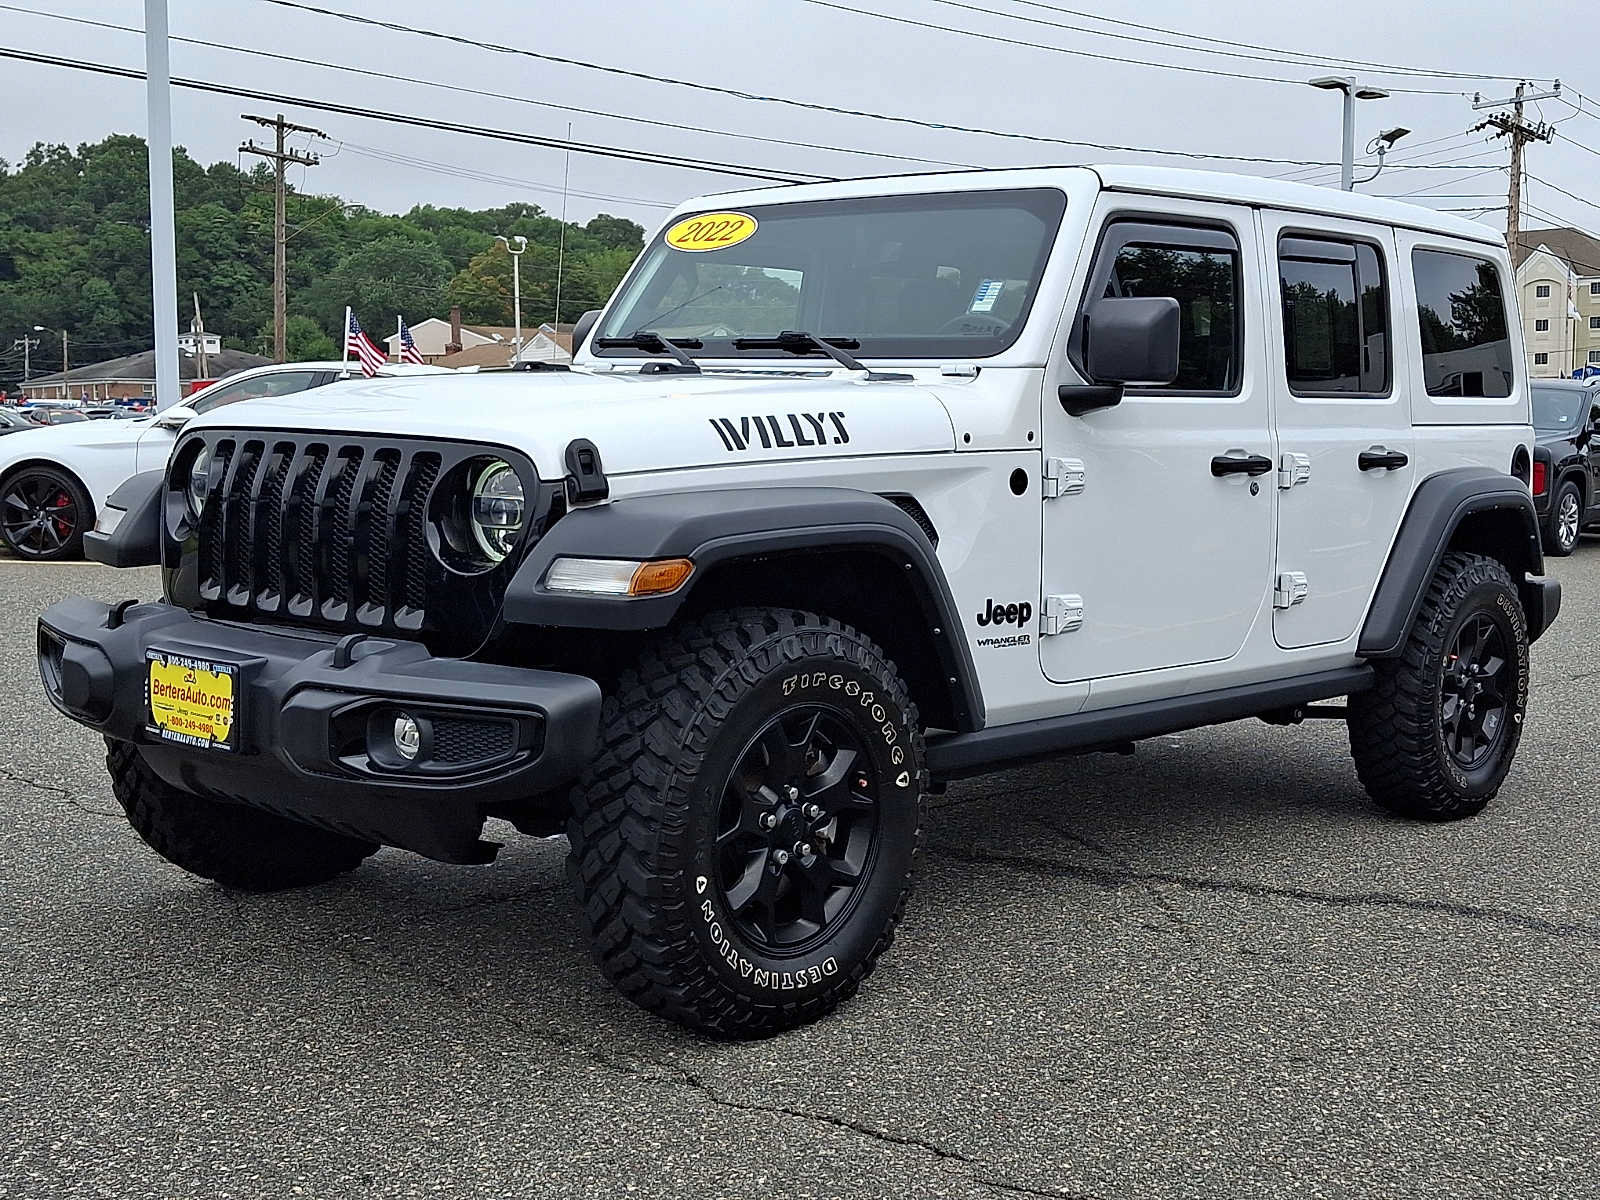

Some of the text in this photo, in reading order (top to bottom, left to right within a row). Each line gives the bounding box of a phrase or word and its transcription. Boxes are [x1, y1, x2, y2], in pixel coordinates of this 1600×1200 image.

[677, 220, 745, 243] 2022
[709, 411, 850, 452] WILLYS
[976, 598, 1032, 628] Jeep
[976, 634, 1031, 647] WRANGLER
[1497, 593, 1525, 708] DESTINATION
[153, 678, 232, 712] BerteraAuto.com
[166, 714, 214, 734] 1-800-249-4980
[782, 671, 905, 765] Firestone
[701, 899, 838, 990] DESTINATION
